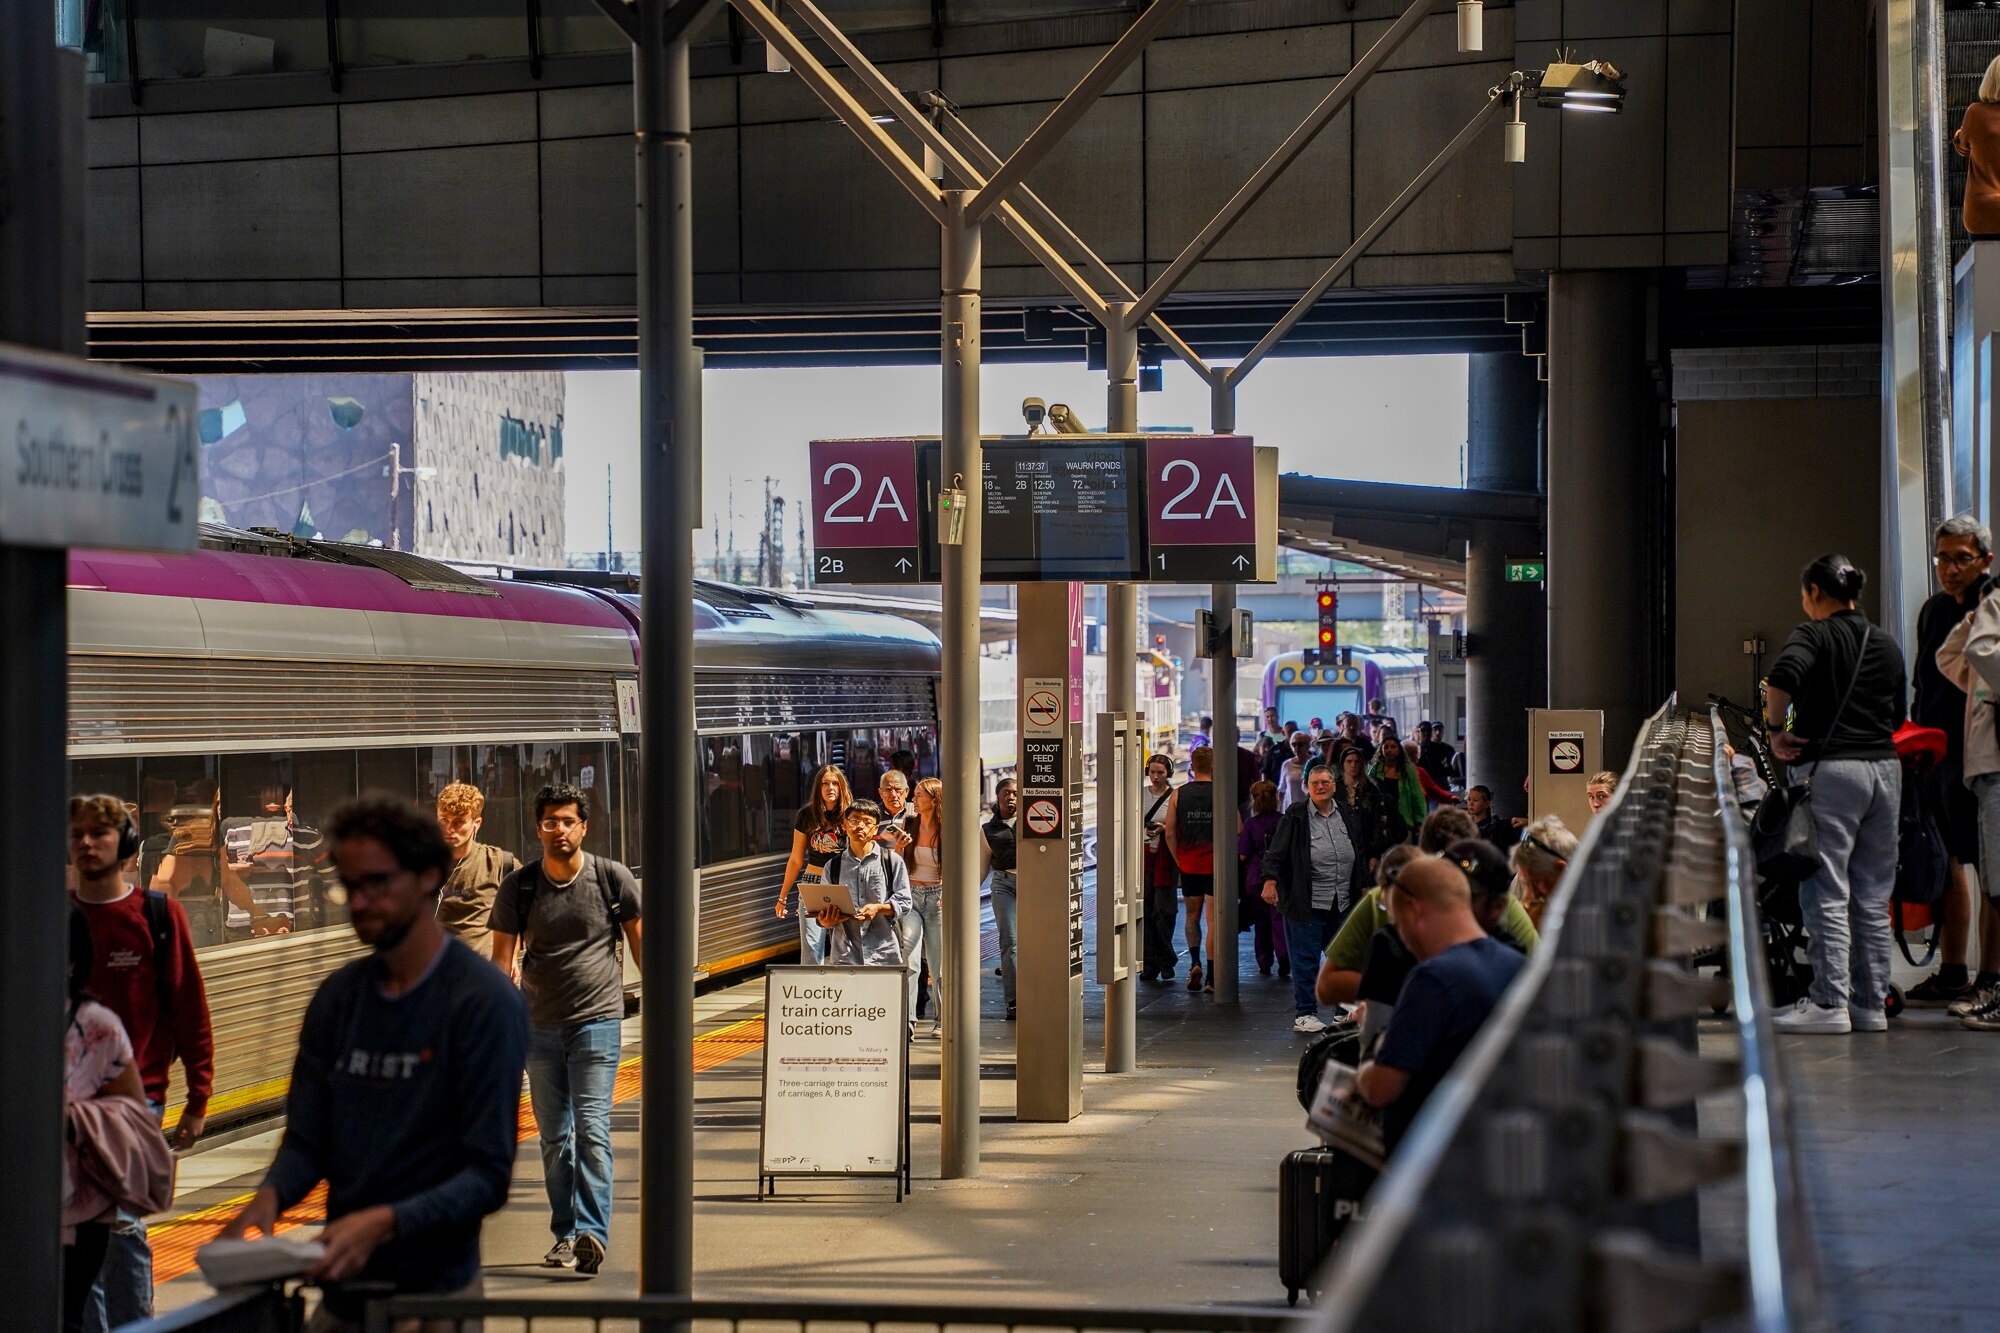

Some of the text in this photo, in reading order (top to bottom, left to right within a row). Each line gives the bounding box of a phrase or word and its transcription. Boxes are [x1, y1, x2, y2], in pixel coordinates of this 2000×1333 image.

[1018, 462, 1045, 471] 11:37:37
[1066, 461, 1121, 470] WAURN PONDS
[983, 480, 994, 490] 18
[1015, 480, 1027, 490] 2B
[1033, 480, 1055, 490] 12:50
[1072, 480, 1083, 489] 72
[1111, 480, 1116, 489] 1
[1160, 458, 1247, 521] 2A
[822, 462, 909, 524] 2A
[819, 556, 844, 574] 2B
[1157, 553, 1166, 571] 1
[1026, 744, 1060, 753] DO NOT
[1032, 754, 1054, 763] FEED
[1035, 764, 1052, 773] THE
[1031, 774, 1056, 783] BIRDS
[782, 985, 843, 1003] VLocity
[781, 1004, 886, 1021] train carriage
[780, 1022, 853, 1036] locations
[778, 1079, 888, 1089] Three-carriage trains consist
[778, 1090, 787, 1098] of
[787, 1090, 823, 1098] carriages
